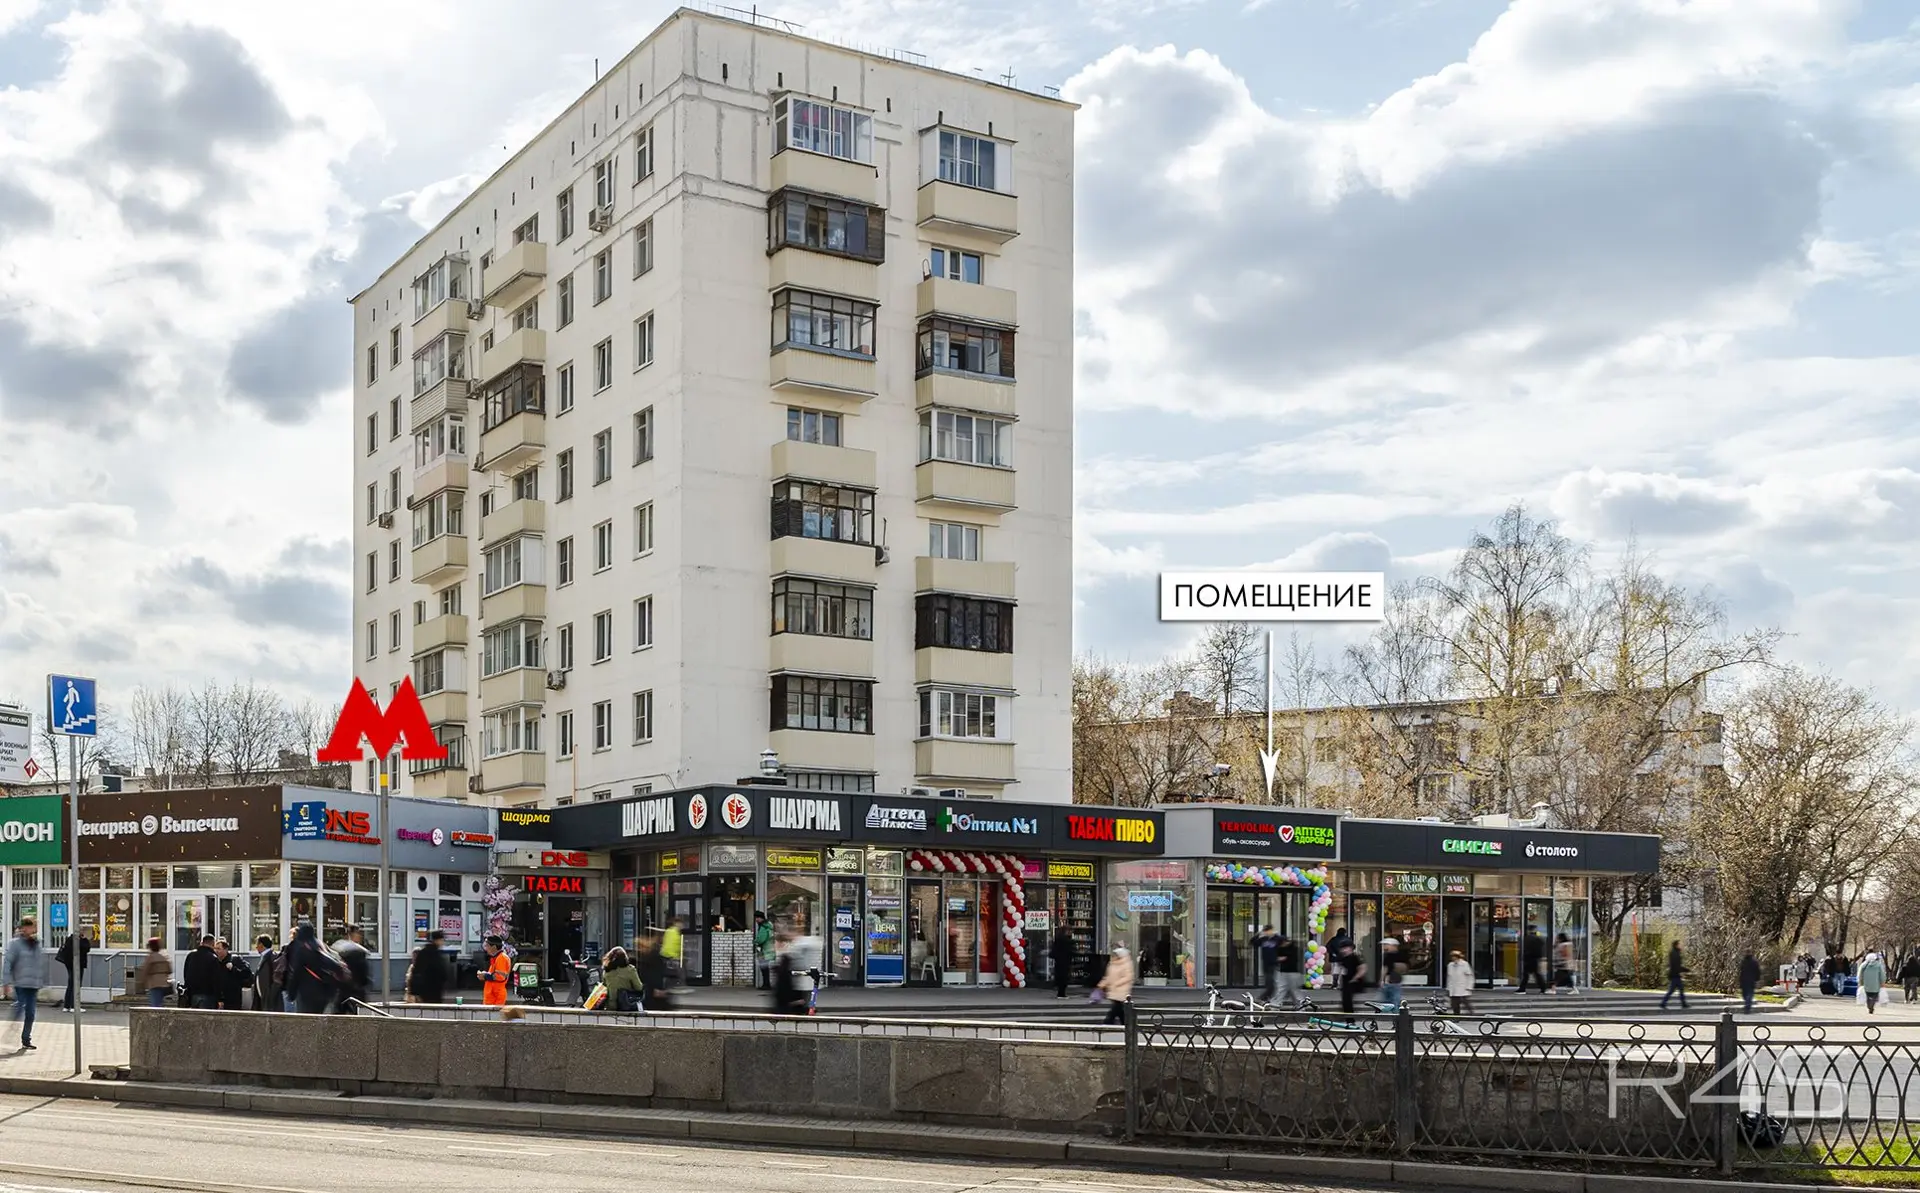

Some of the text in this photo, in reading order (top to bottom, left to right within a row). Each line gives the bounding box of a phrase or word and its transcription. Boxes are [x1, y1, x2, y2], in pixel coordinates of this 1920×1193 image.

[622, 796, 676, 838] ШАУРМА
[769, 797, 841, 831] ШАУРМА
[867, 803, 926, 820] Аптека
[161, 816, 239, 833] Выпечка
[501, 811, 551, 826] шаурма
[880, 819, 914, 829] Плюс
[957, 813, 1038, 834] Оптика №1
[1068, 815, 1155, 843] ТАБАК ПИВО
[1219, 821, 1275, 834] TERVOLINA
[1294, 826, 1335, 838] АПТЕКА
[433, 832, 442, 841] 24
[1222, 837, 1237, 845] обувь
[1294, 835, 1325, 845] ЗДОРОВ
[1442, 839, 1491, 854] САМСА
[1535, 846, 1579, 857] СТОЛОТО
[541, 852, 589, 867] DNS
[778, 856, 818, 865] ВЫПЕЧКА
[1049, 864, 1091, 877] НАПИТКИ
[526, 876, 583, 892] ТАБАК
[1443, 875, 1470, 884] САМСА
[1398, 883, 1425, 891] САМСА
[838, 915, 852, 925] 9-21
[875, 923, 897, 933] ЦЕНА
